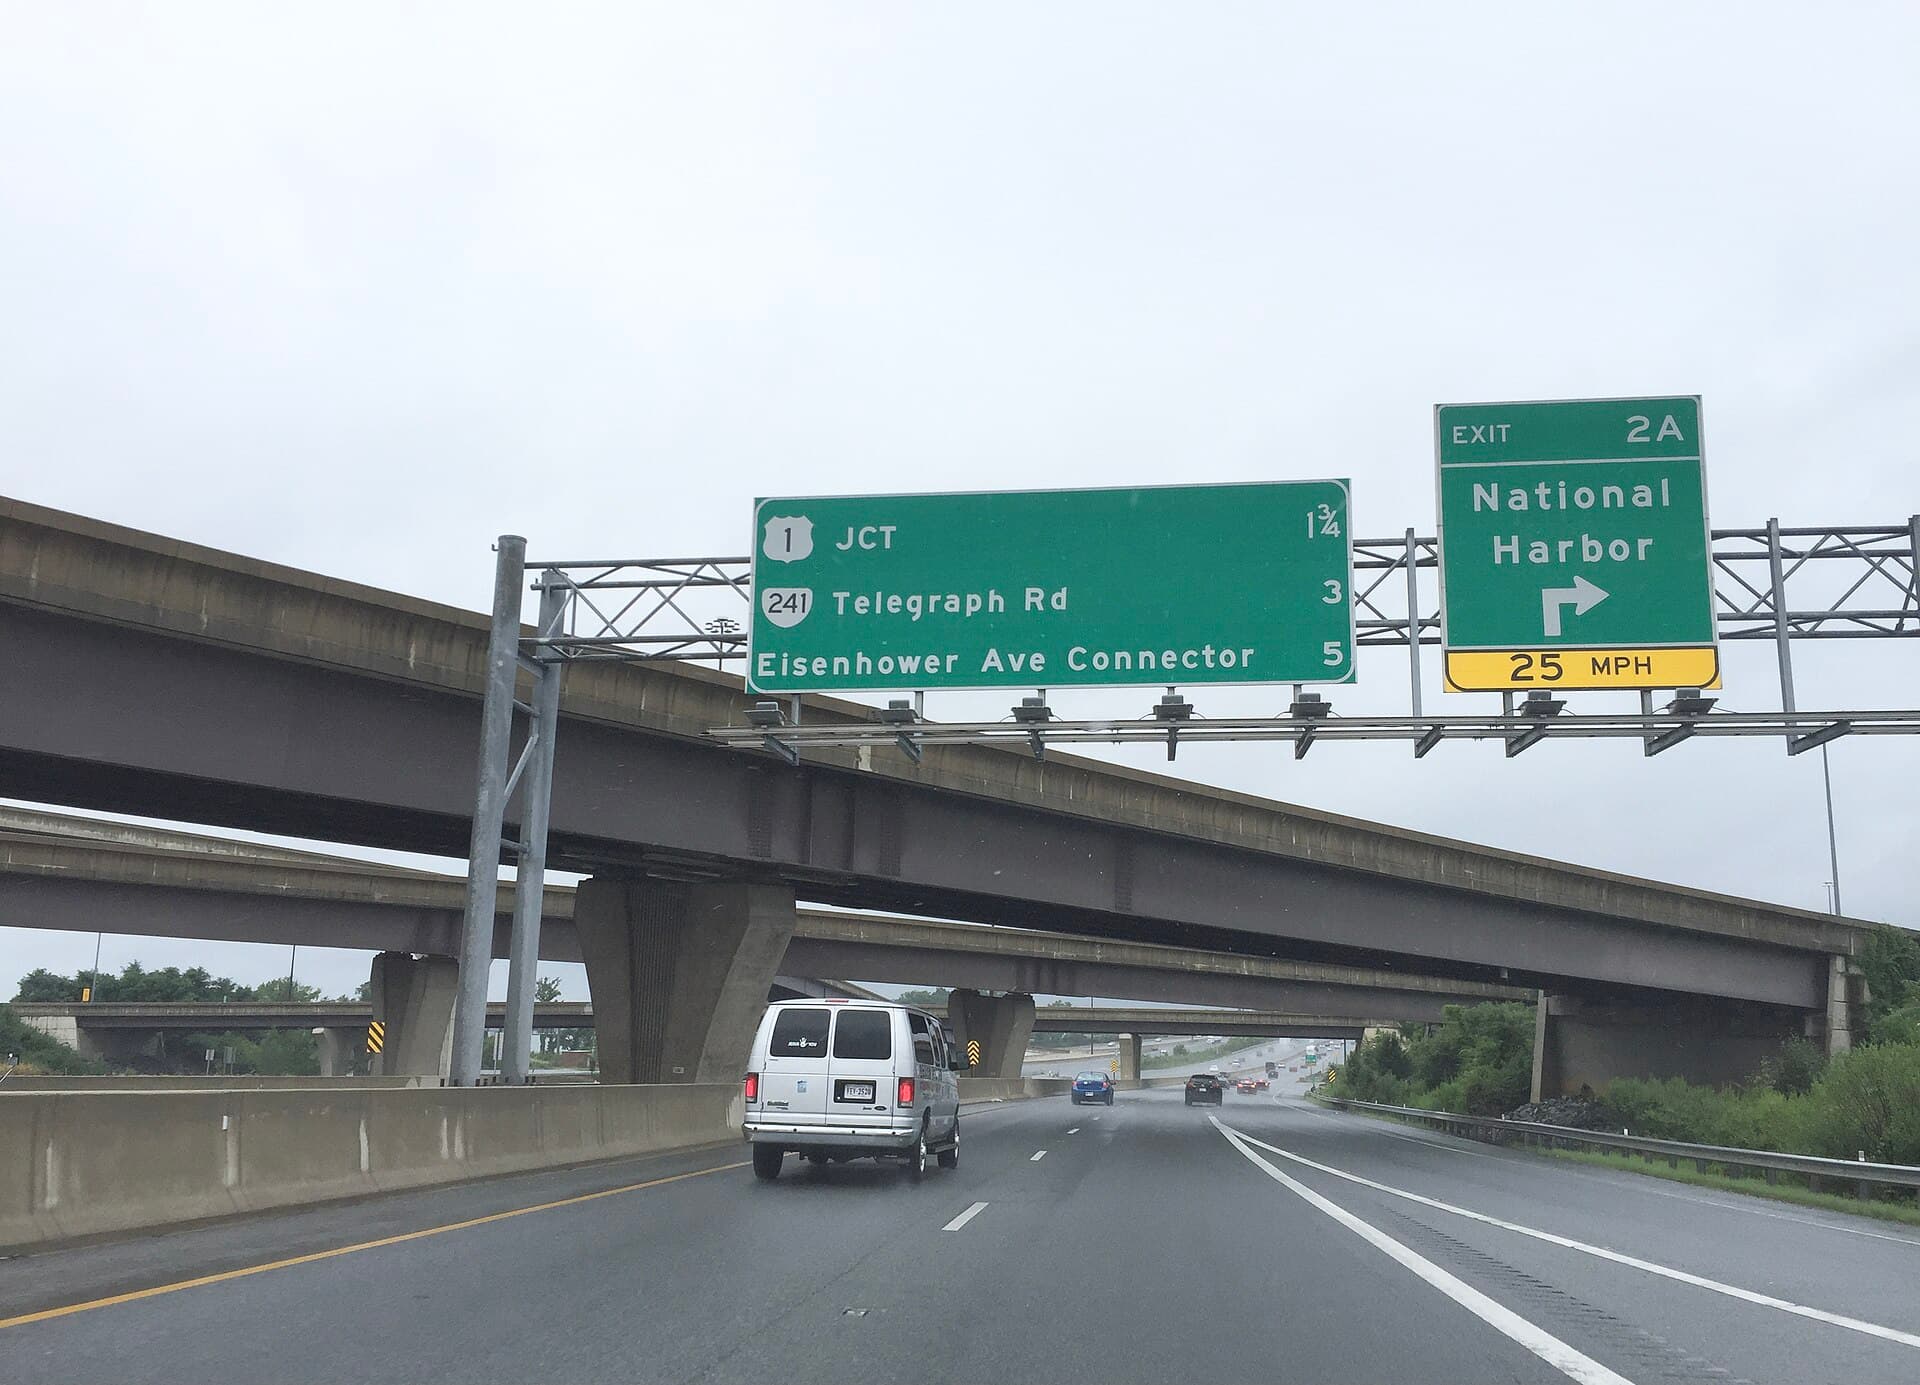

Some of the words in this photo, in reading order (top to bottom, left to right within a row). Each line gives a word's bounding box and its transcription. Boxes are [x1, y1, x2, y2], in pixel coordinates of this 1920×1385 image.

[1453, 424, 1511, 444] EXIT
[1626, 415, 1684, 443] 2A
[1473, 478, 1670, 512] National
[784, 527, 792, 553] 1
[835, 526, 897, 551] JCT
[1493, 534, 1654, 564] Harbor
[768, 593, 807, 615] 241
[833, 590, 1005, 621] Telegraph
[1025, 587, 1068, 612] Rd
[1322, 580, 1342, 604] 3
[757, 650, 958, 678] Eisenhower
[982, 647, 1046, 673] Ave
[1068, 642, 1254, 671] Connector
[1323, 642, 1344, 666] 5
[1510, 653, 1563, 681] 25
[1591, 656, 1652, 675] MPH
